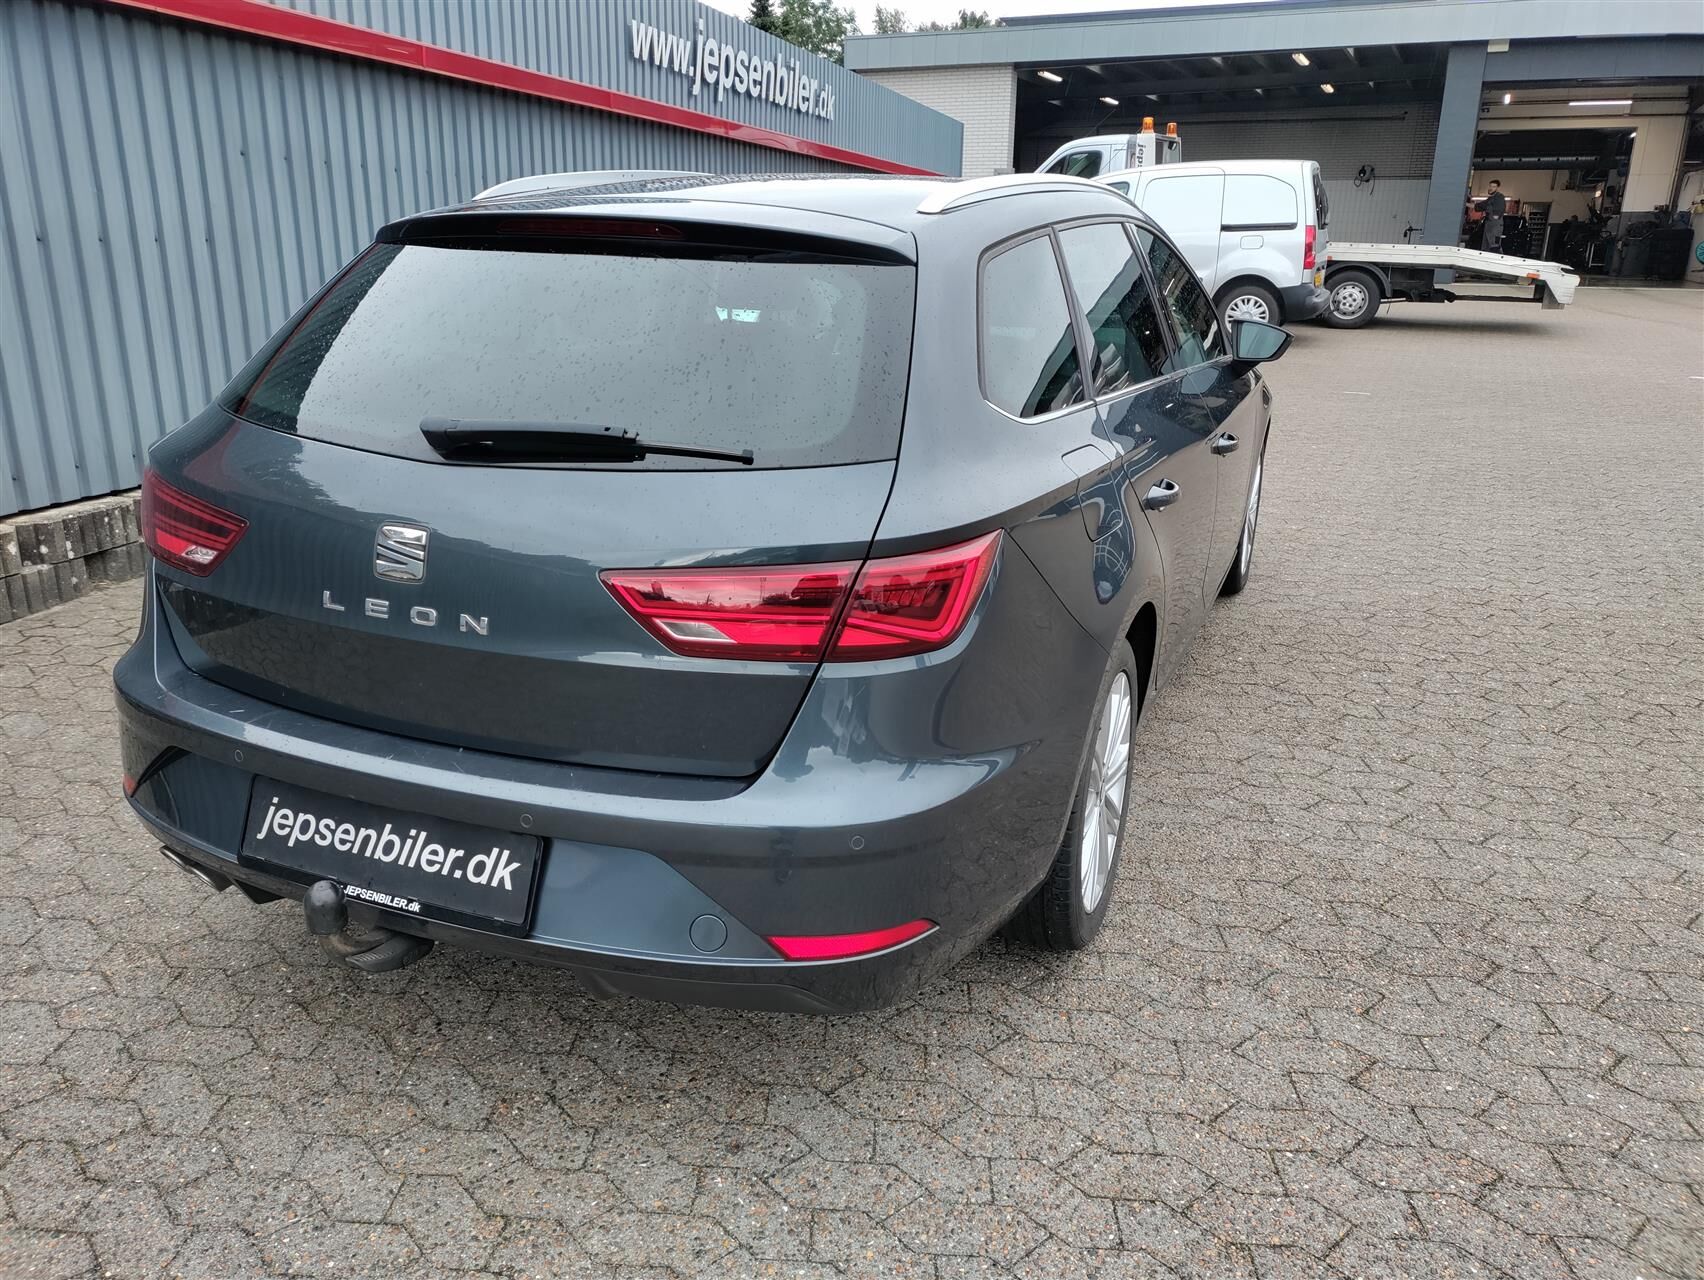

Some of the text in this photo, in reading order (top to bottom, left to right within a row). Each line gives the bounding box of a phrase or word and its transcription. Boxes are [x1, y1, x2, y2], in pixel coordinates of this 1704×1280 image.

[632, 19, 835, 120] www.jepsenbiler.dk
[322, 590, 489, 636] LEON
[256, 797, 521, 891] jepsenbiler.dk
